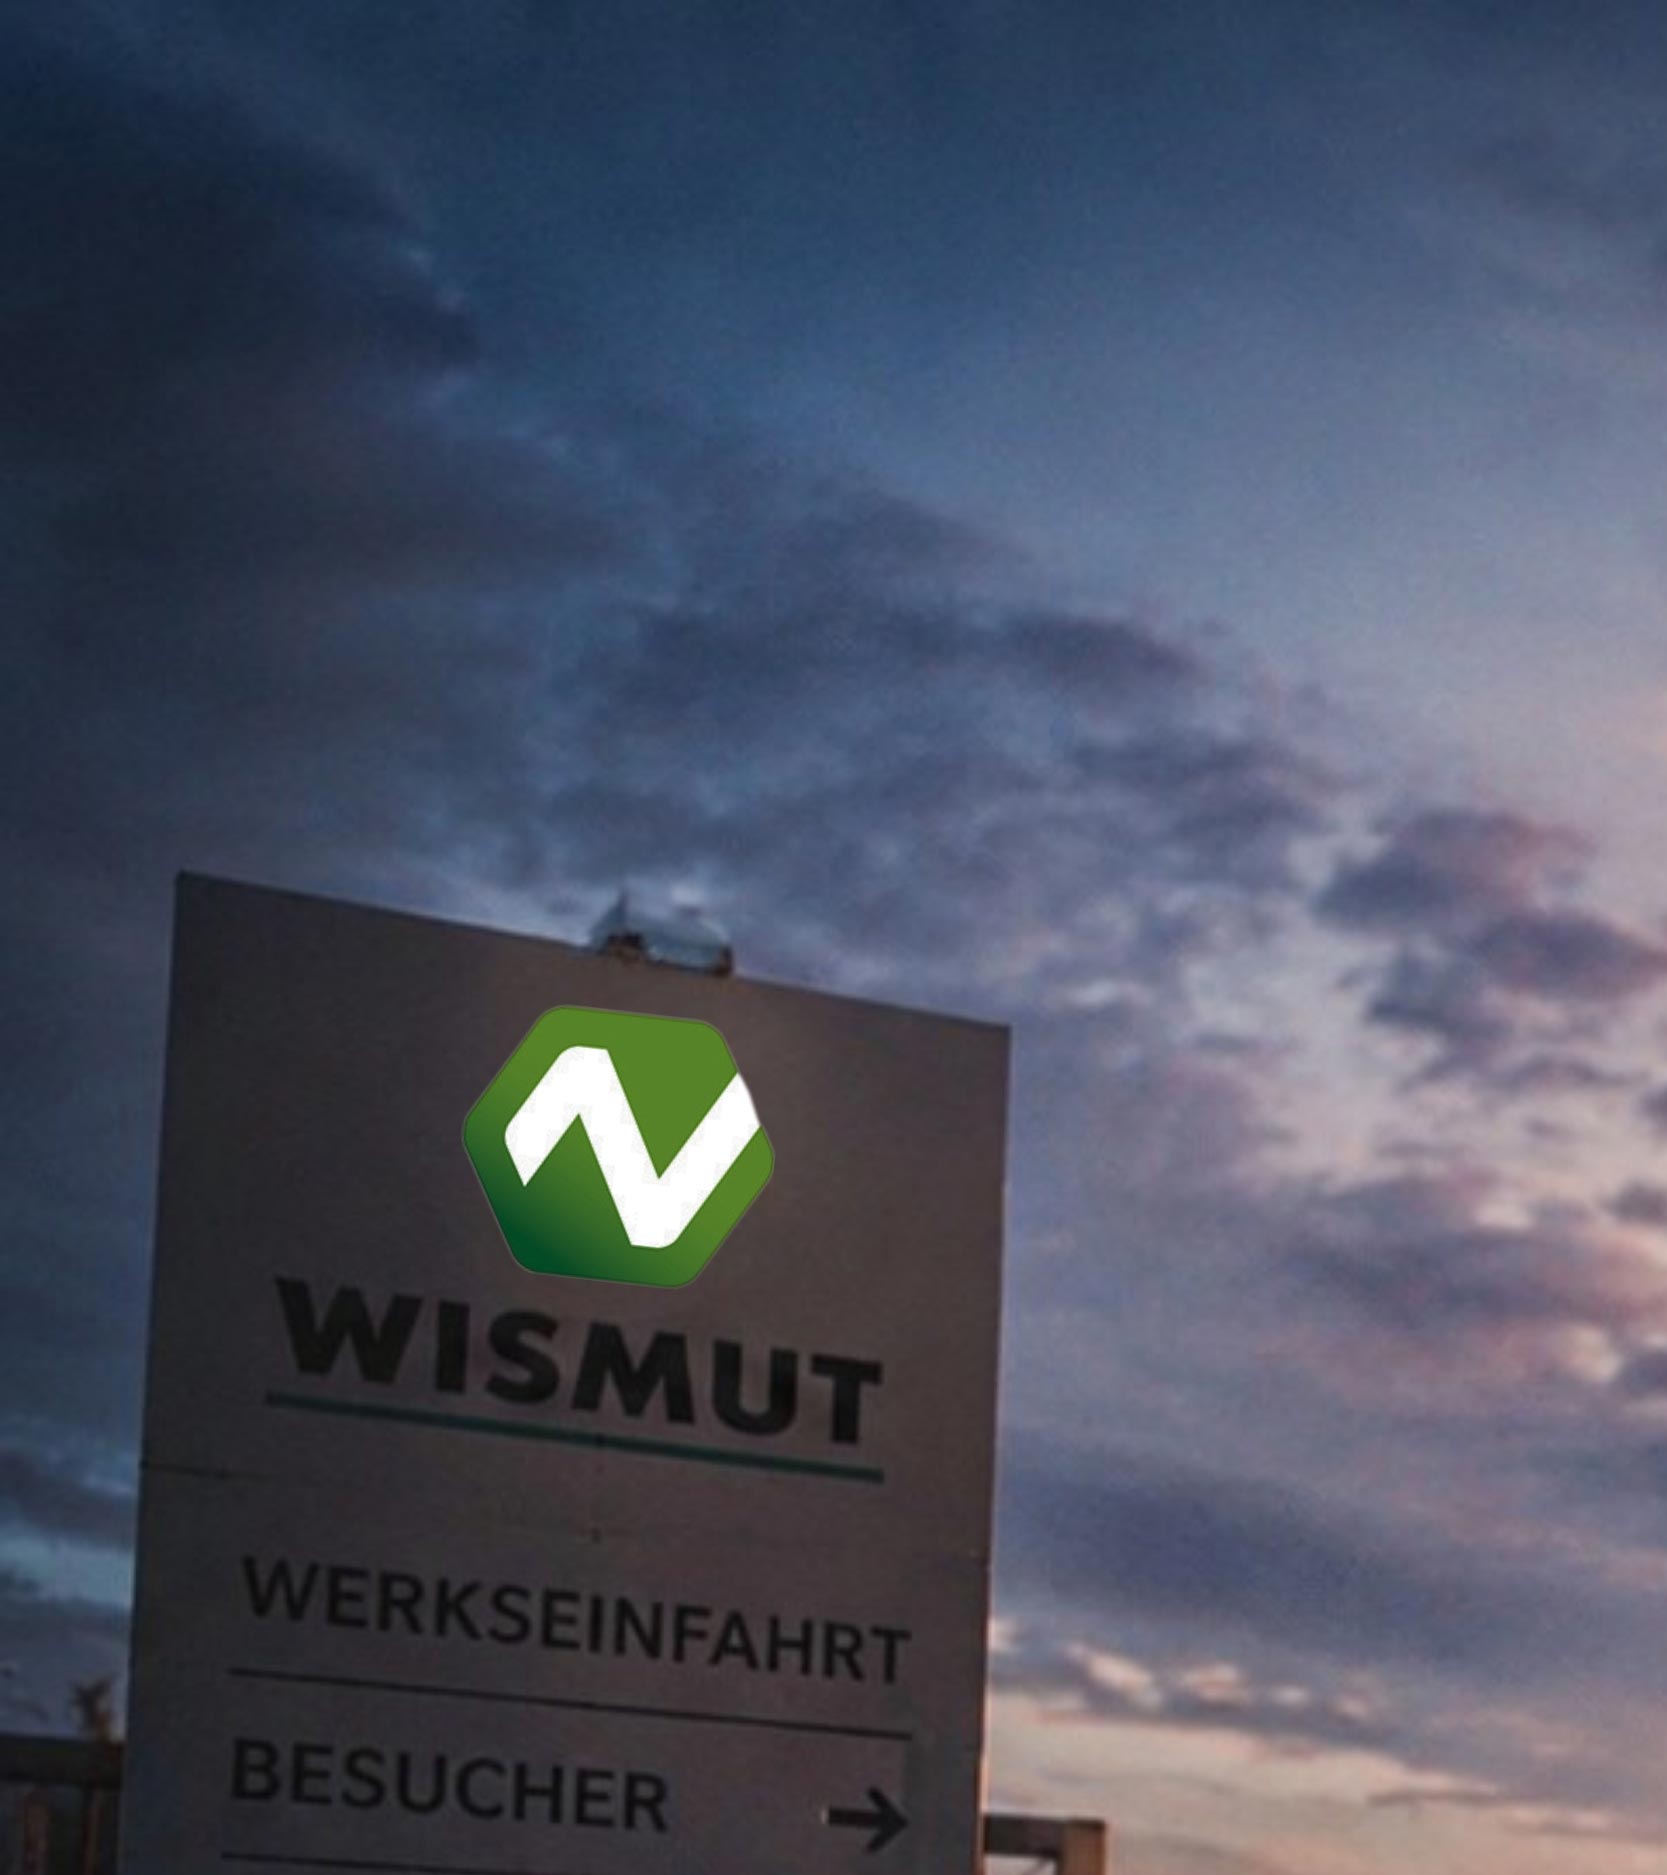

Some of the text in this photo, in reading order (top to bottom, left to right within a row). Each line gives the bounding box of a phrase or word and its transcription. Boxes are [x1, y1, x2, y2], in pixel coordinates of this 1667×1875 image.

[274, 1276, 884, 1446] WISMUT
[241, 1556, 912, 1686] WERKSEINFAHRT
[230, 1737, 670, 1833] BESUCHER
